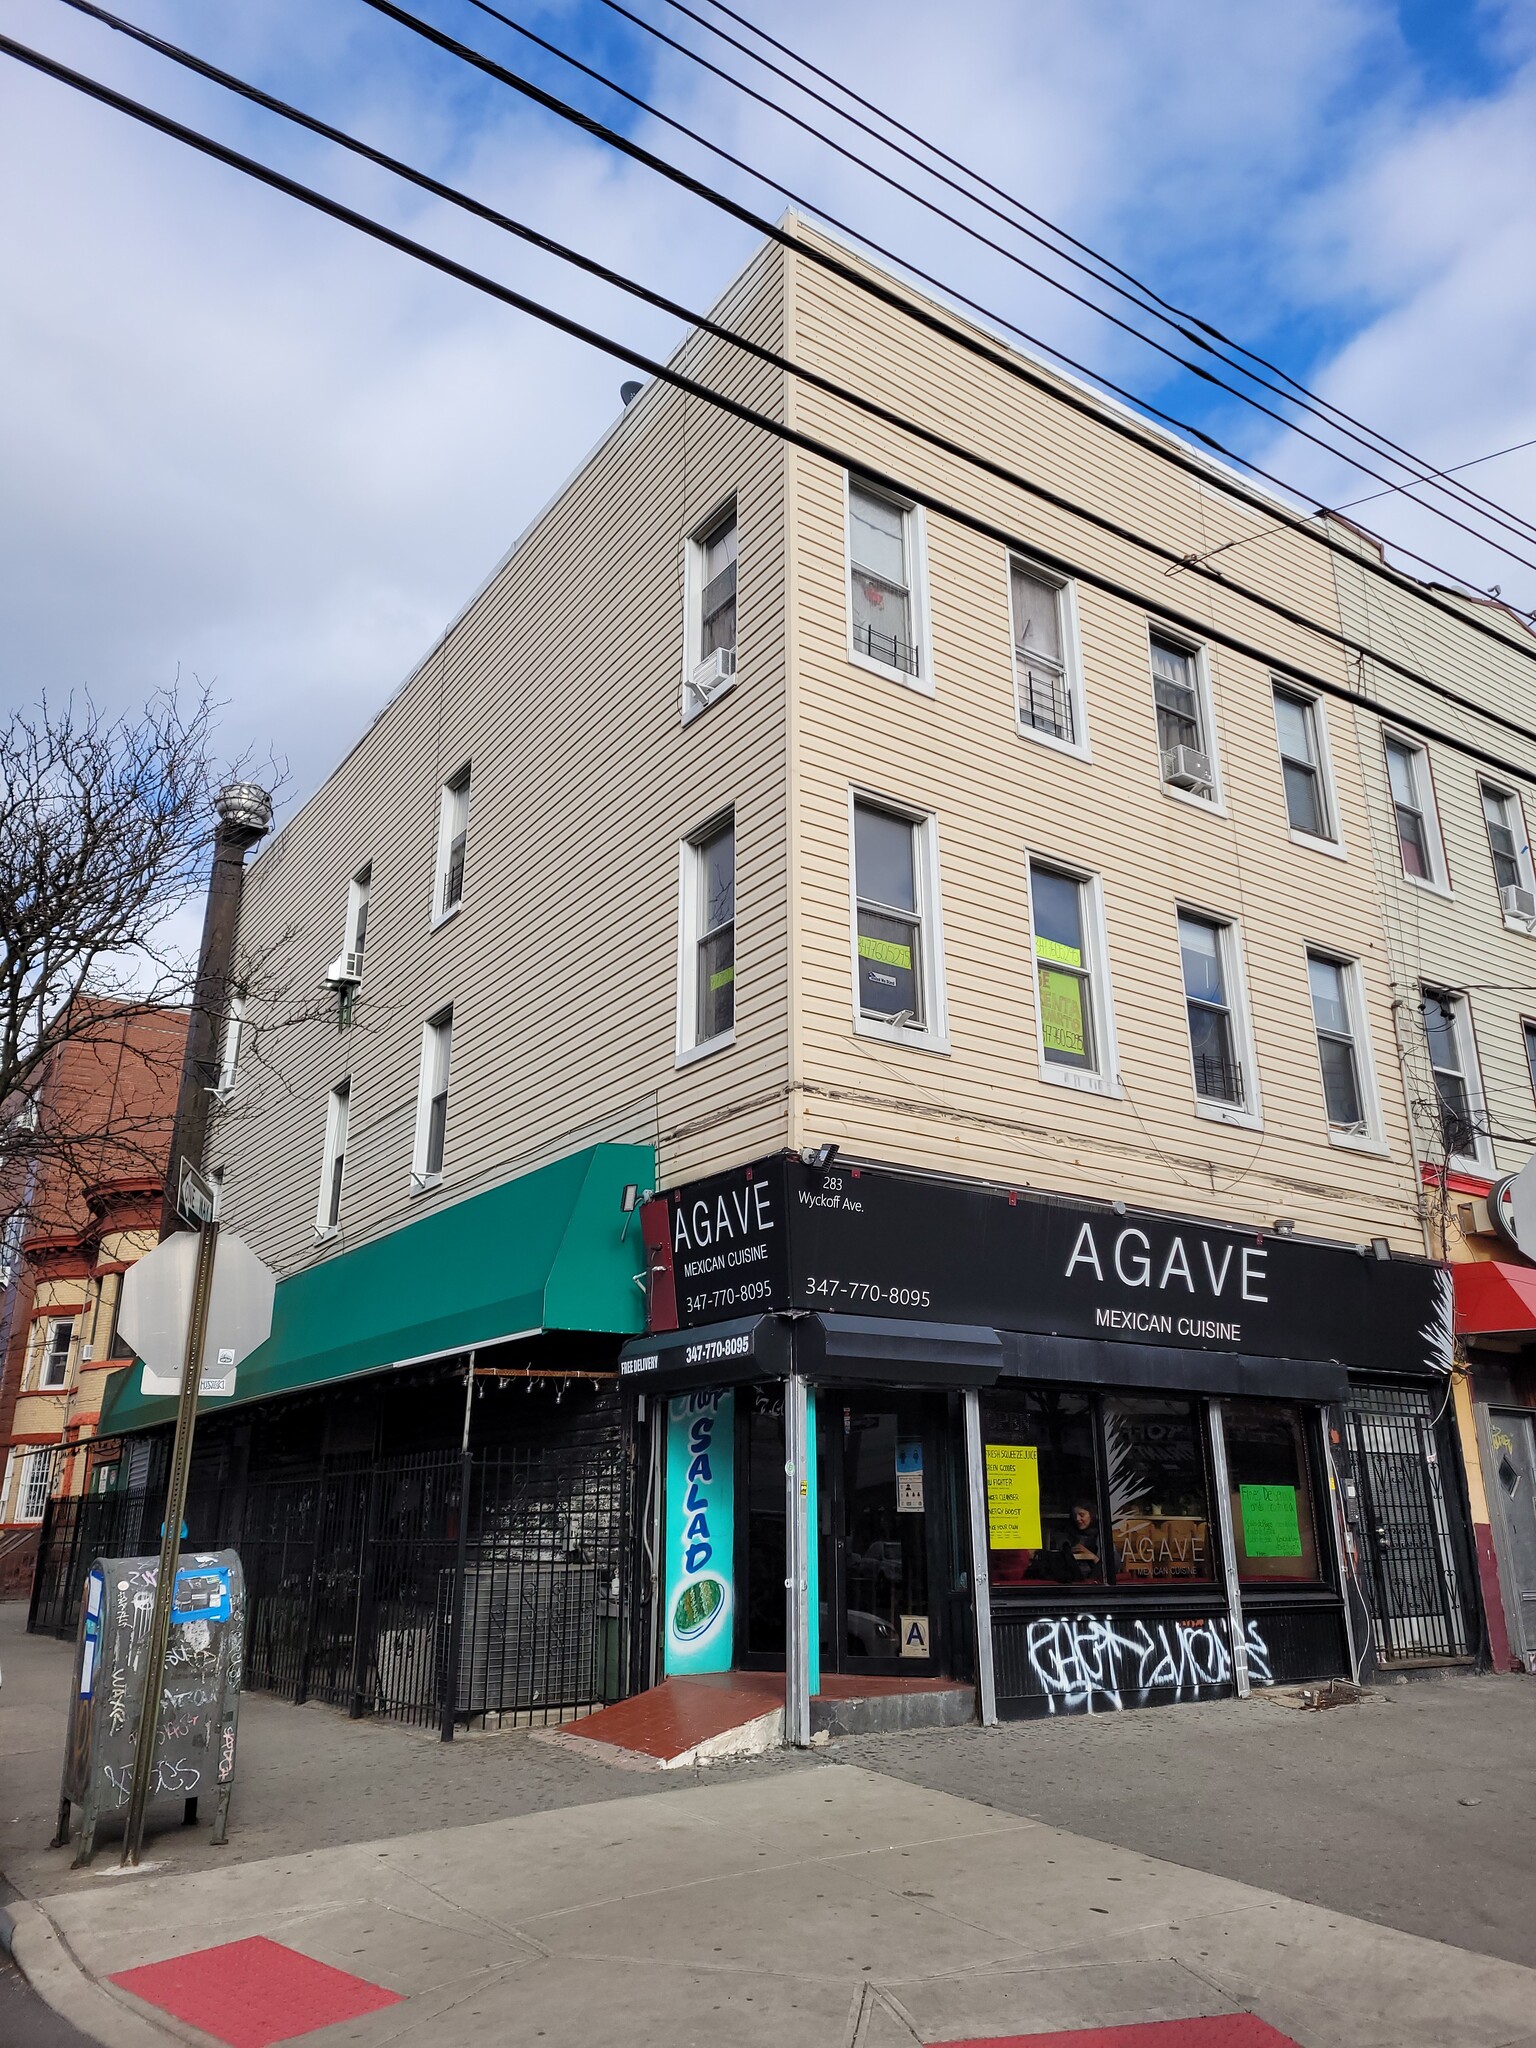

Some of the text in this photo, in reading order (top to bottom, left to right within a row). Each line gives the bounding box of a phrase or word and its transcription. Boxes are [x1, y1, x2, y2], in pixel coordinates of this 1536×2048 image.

[1042, 1023, 1084, 1051] 477605295
[822, 1176, 843, 1191] 283
[185, 1180, 210, 1222] ONE WAY
[674, 1180, 775, 1253] AGAVE
[798, 1190, 865, 1213] Wyckoff Ave.
[684, 1243, 769, 1278] MEXICAN CUISINE
[1065, 1222, 1268, 1303] AGAVE
[686, 1279, 773, 1313] 347-770-8095
[805, 1277, 931, 1308] 347-770-8095
[1096, 1308, 1241, 1342] MEXICAN CUISINE
[685, 1335, 750, 1364] 347-770-8095
[620, 1355, 659, 1376] FREE DELIVERY
[684, 1417, 715, 1574] SALAD
[1121, 1537, 1205, 1563] AGAVE
[906, 1621, 925, 1646] A
